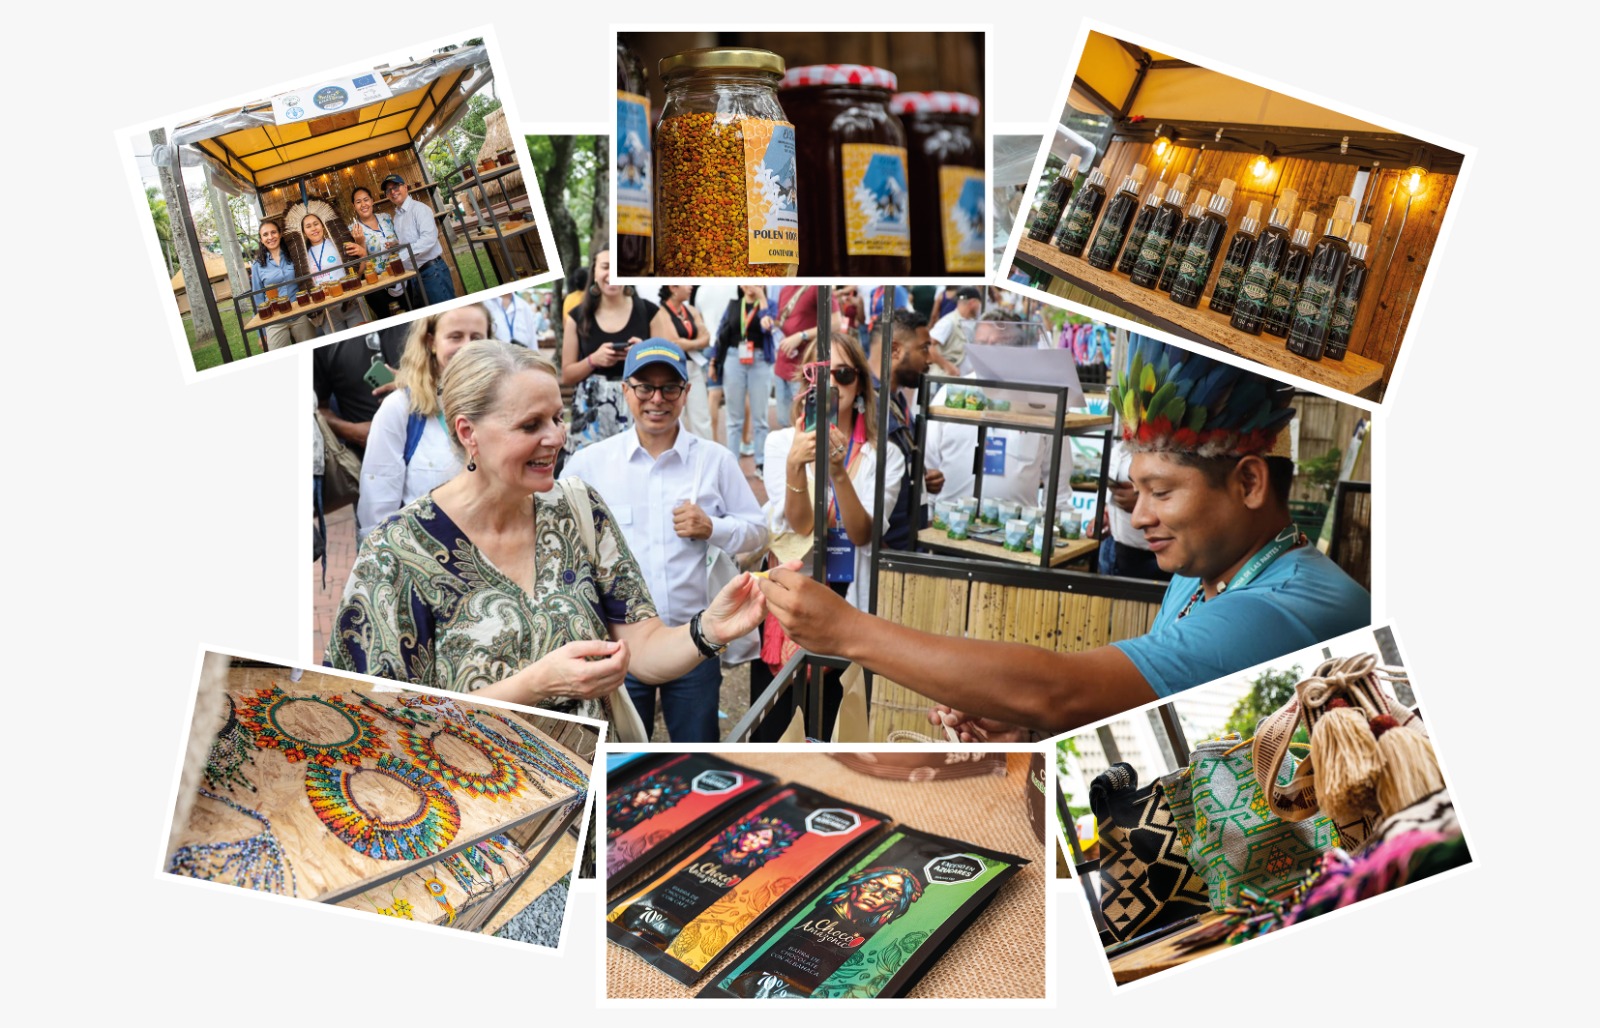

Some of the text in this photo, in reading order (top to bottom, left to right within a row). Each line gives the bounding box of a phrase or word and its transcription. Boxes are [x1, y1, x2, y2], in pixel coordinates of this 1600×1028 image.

[753, 229, 783, 239] POLEN
[1250, 561, 1262, 572] LAS
[1260, 546, 1279, 564] PARTES
[700, 862, 733, 883] Choco
[639, 906, 668, 930] 70%
[815, 919, 853, 943] Choco
[780, 950, 818, 969] CHOCOLATE
[788, 946, 810, 958] BARRA
[770, 952, 784, 961] CON
[784, 958, 819, 977] ALBAHACA
[757, 971, 790, 998] 70%
